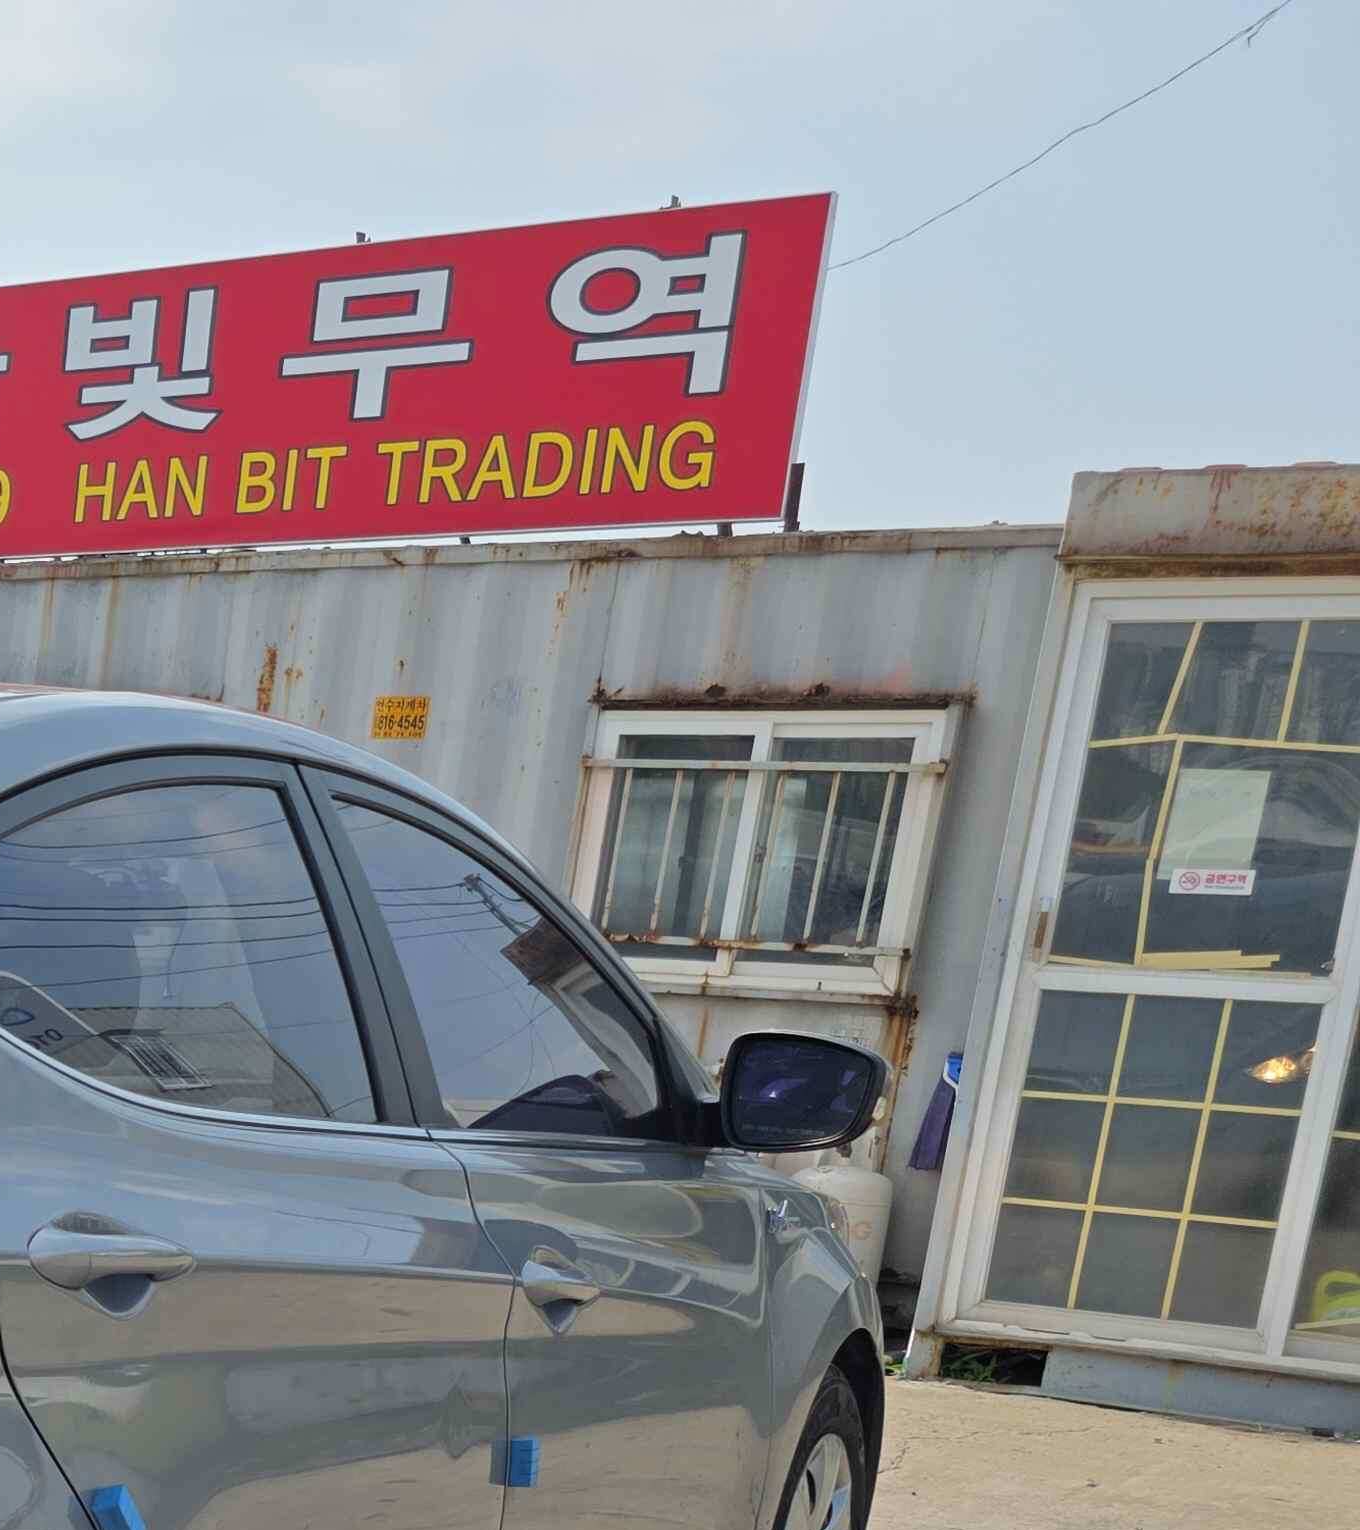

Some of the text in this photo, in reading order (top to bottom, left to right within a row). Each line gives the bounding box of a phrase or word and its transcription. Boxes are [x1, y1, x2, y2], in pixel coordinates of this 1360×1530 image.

[73, 418, 718, 525] HAN BIT TRADING
